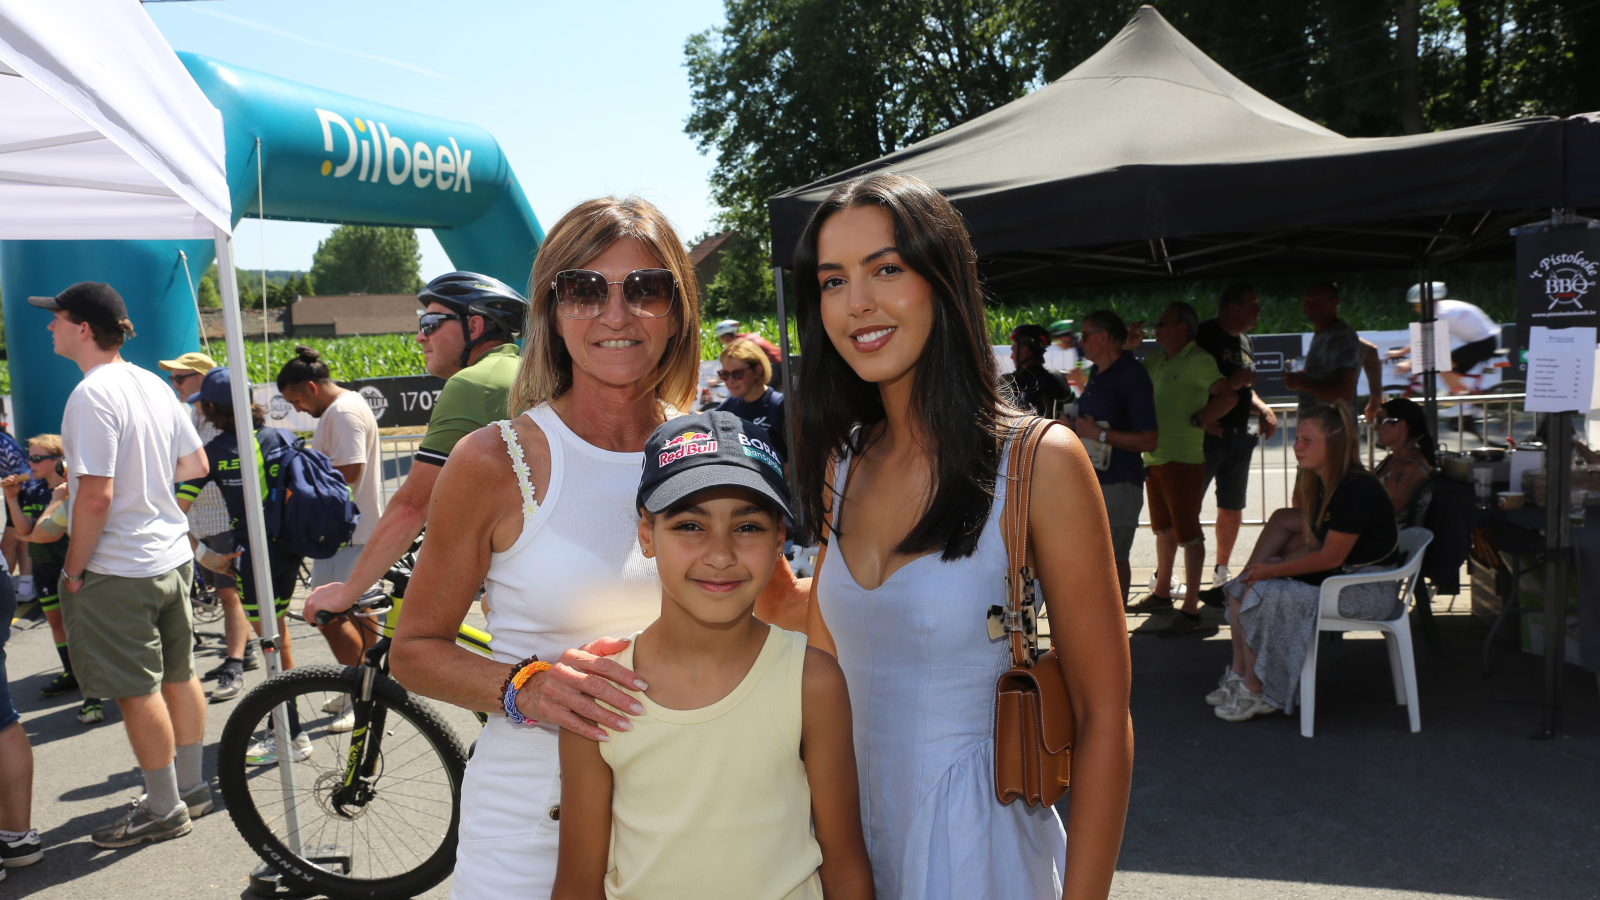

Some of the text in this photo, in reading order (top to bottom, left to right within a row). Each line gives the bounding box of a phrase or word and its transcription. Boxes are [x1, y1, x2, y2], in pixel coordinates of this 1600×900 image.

[314, 107, 472, 193] Dilbeek
[1540, 250, 1599, 276] Pistoleeke
[1545, 278, 1589, 294] BBQ
[659, 441, 718, 468] Red Bull
[738, 432, 781, 465] BORA
[262, 843, 314, 882] KENDA
